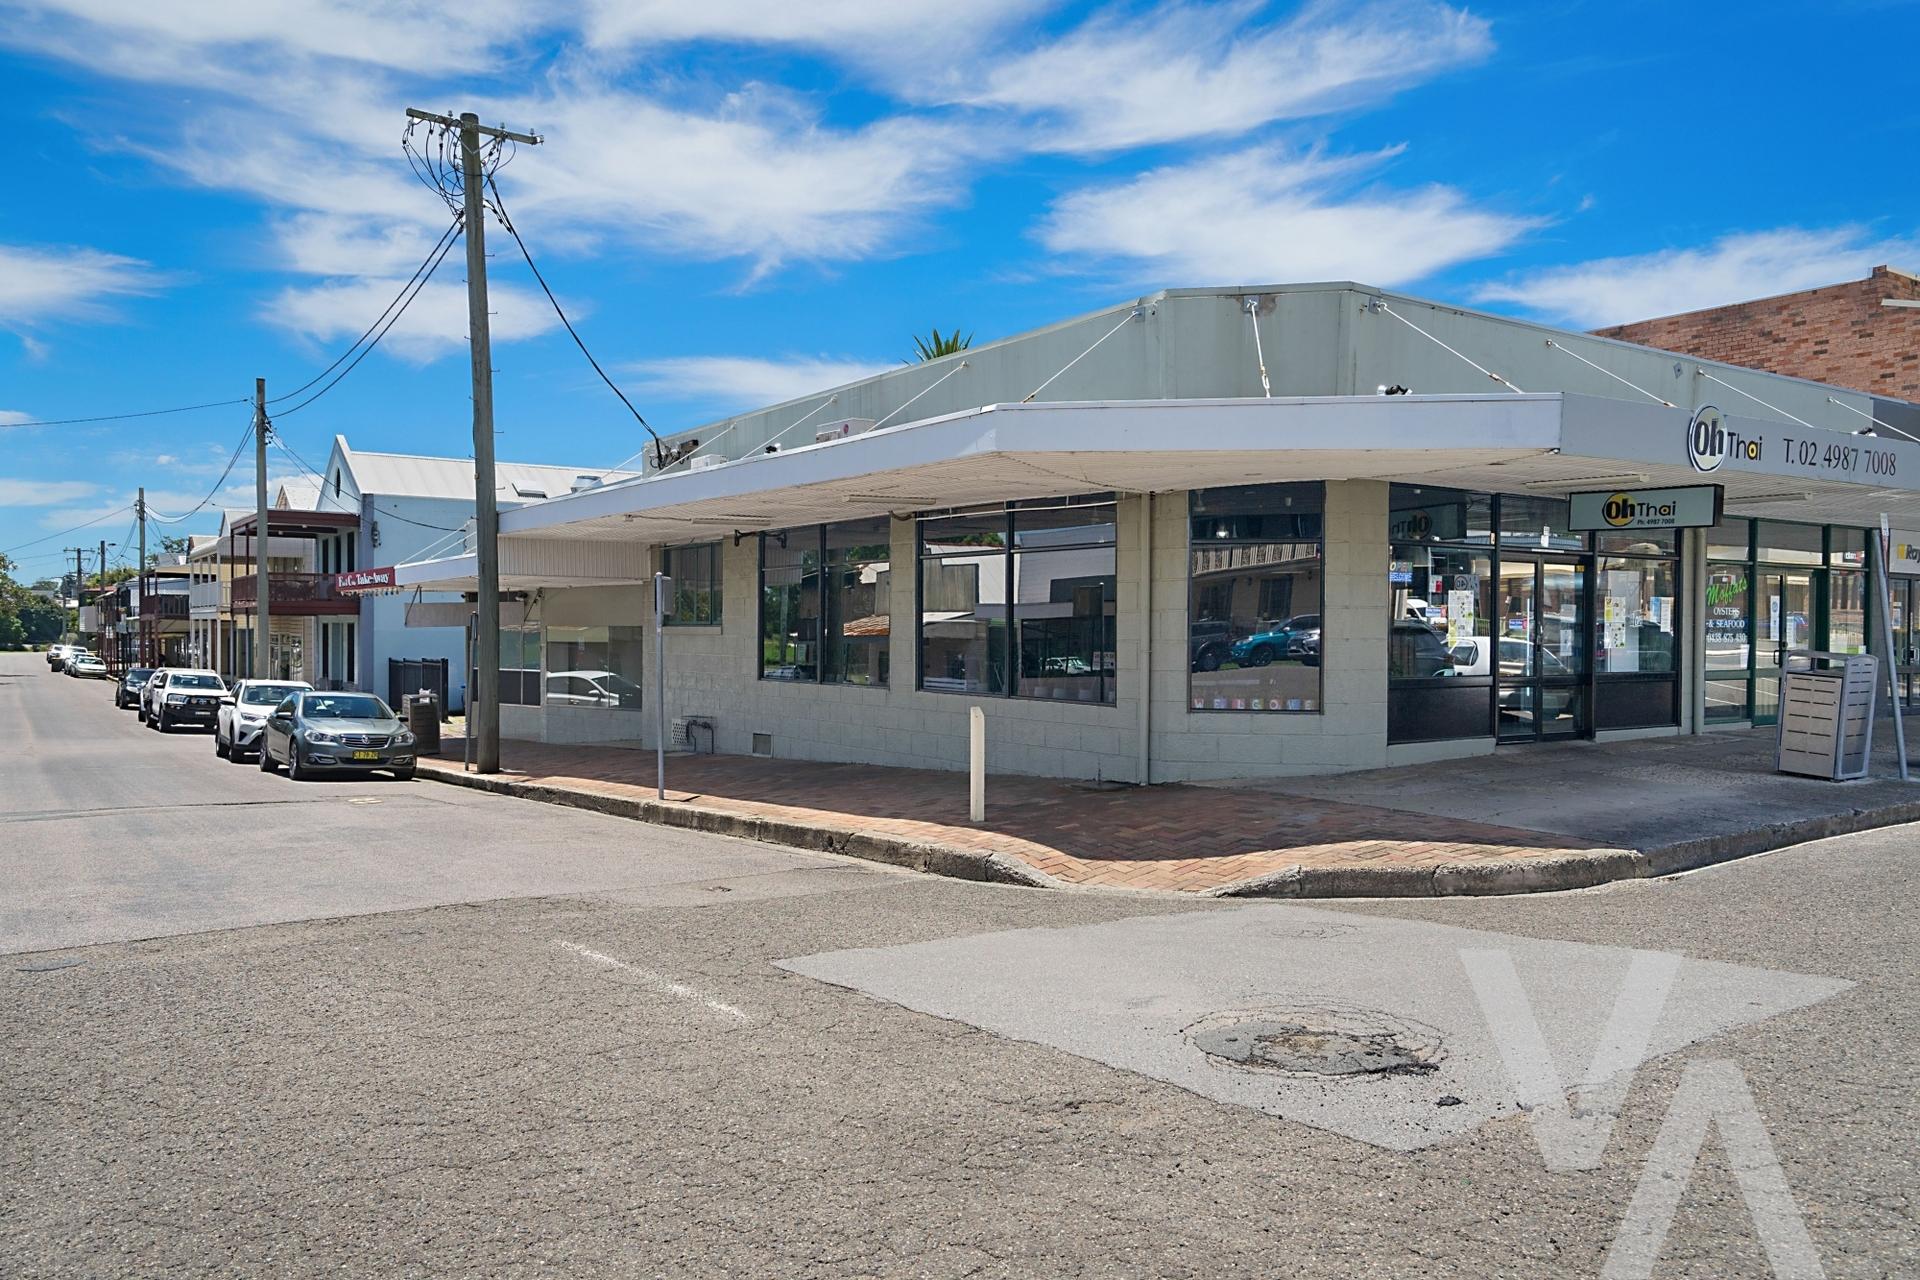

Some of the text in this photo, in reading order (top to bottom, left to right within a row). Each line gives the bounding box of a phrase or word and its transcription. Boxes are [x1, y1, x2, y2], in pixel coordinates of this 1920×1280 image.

[1727, 431, 1762, 461] Thai
[1823, 444, 1859, 472] 4987
[1864, 450, 1897, 476] 7008
[1637, 501, 1676, 516] Thai
[1713, 607, 1740, 616] OYSTERS
[1716, 619, 1745, 628] SEAFOOD
